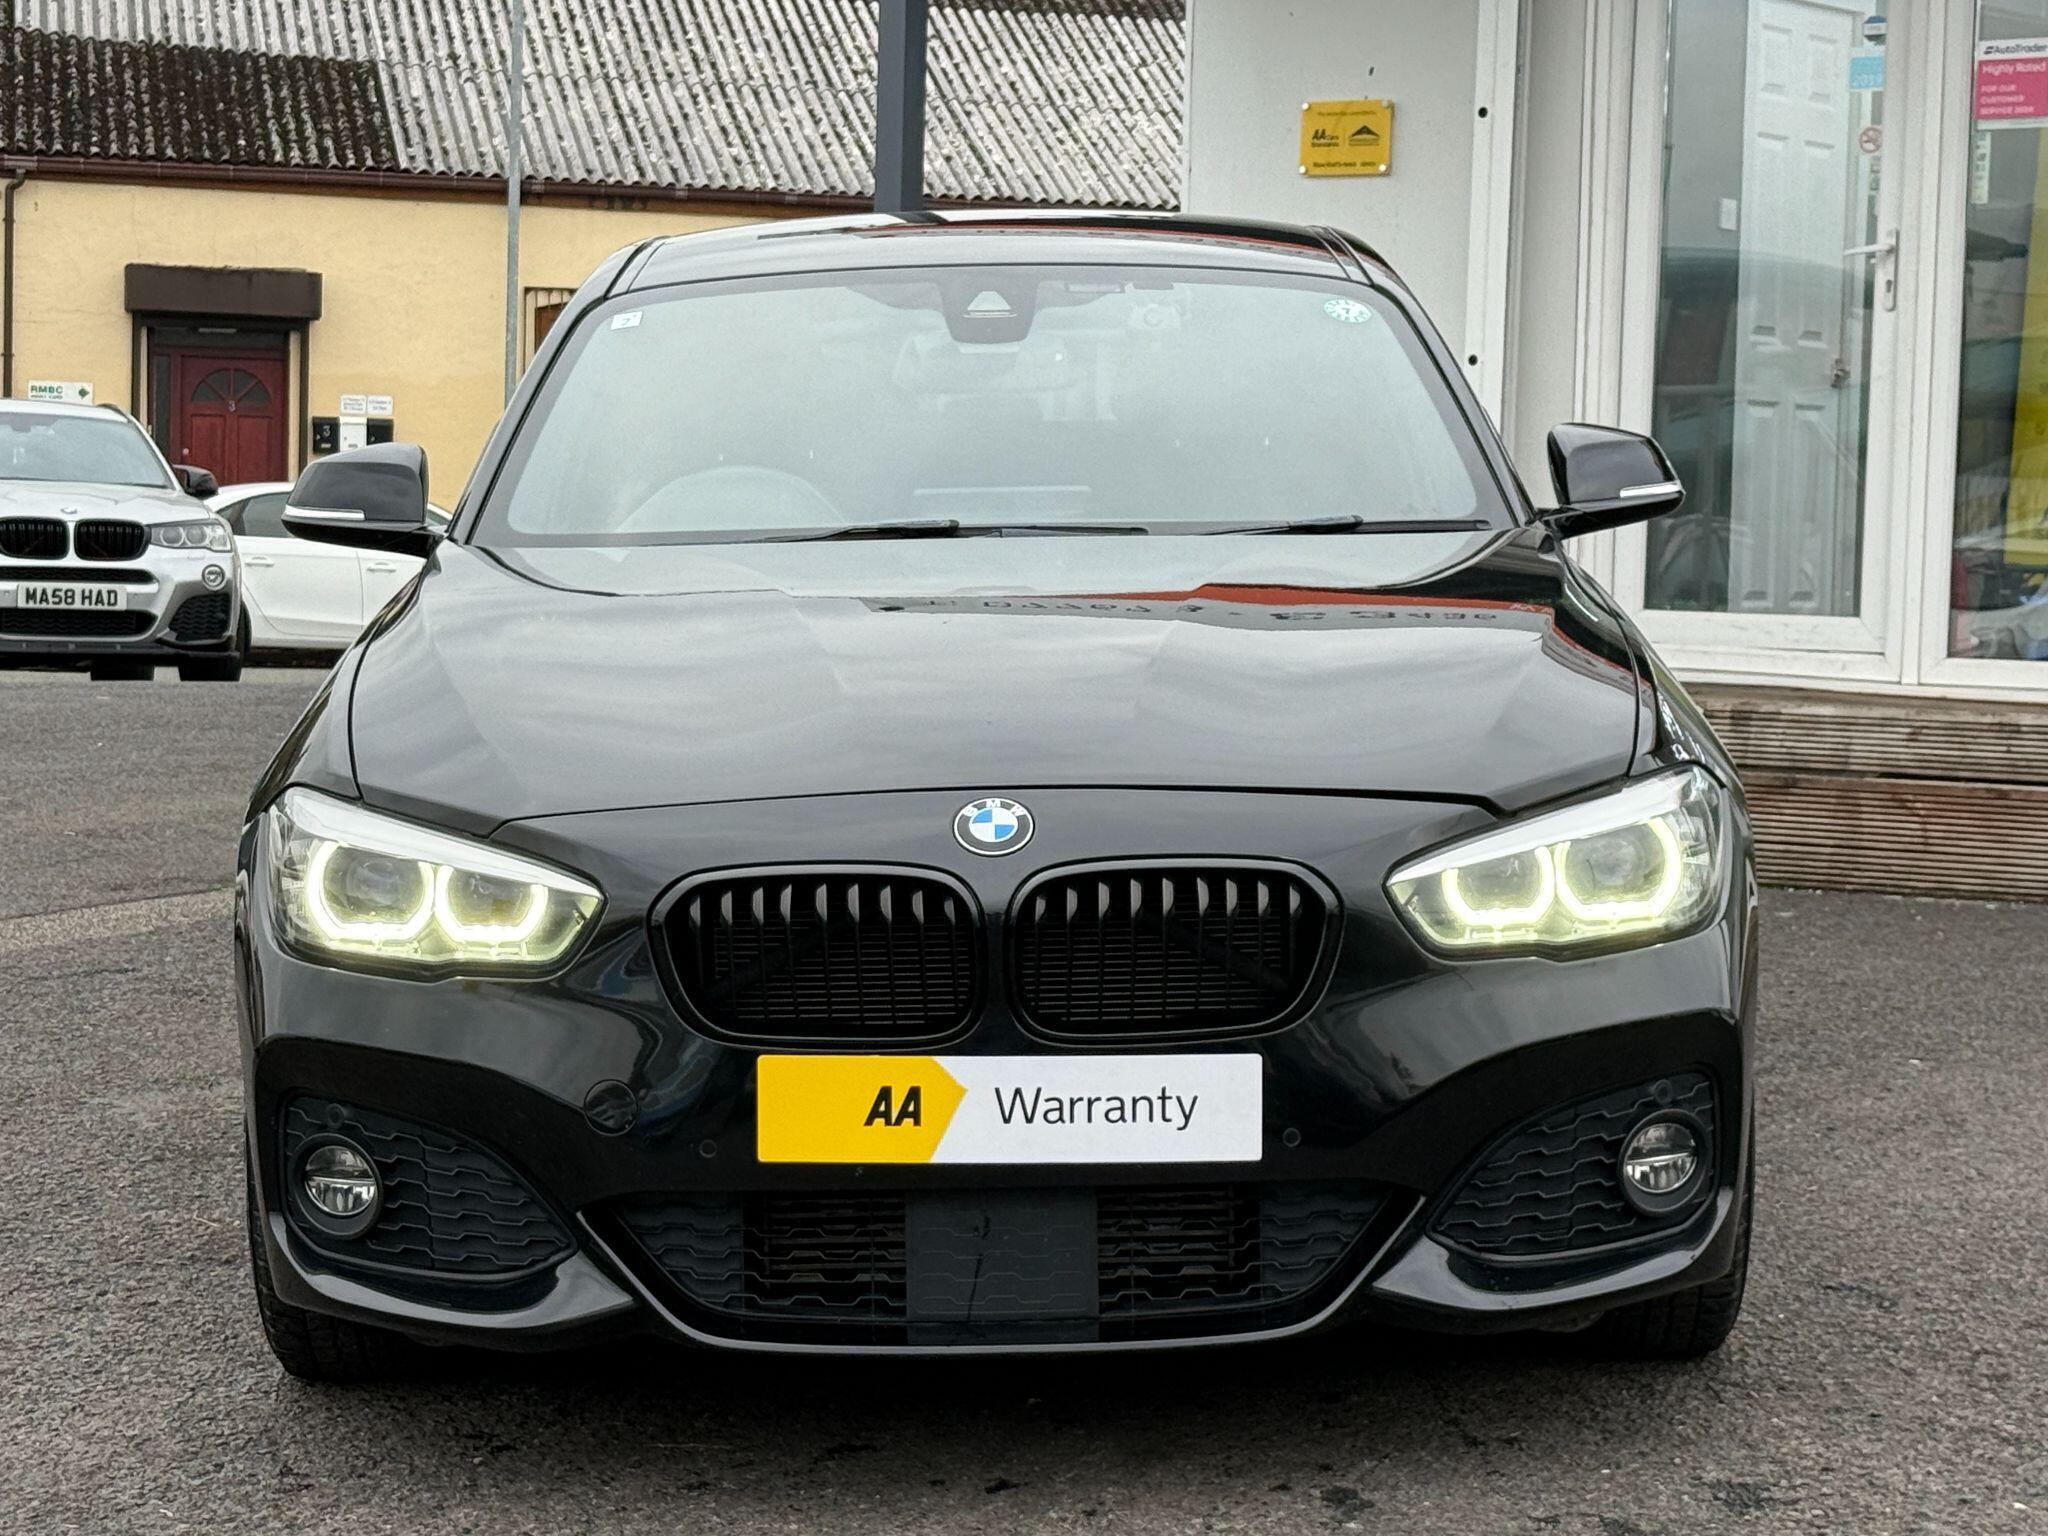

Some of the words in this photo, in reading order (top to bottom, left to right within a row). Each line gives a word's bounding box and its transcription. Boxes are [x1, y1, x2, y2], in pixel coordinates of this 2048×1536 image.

[1994, 44, 2047, 54] AutoTrader
[30, 385, 63, 394] RMBC
[25, 587, 75, 606] MA58
[81, 588, 118, 607] HAD
[962, 799, 1027, 817] BMW
[863, 1085, 922, 1128] AA
[995, 1085, 1199, 1131] Warranty
